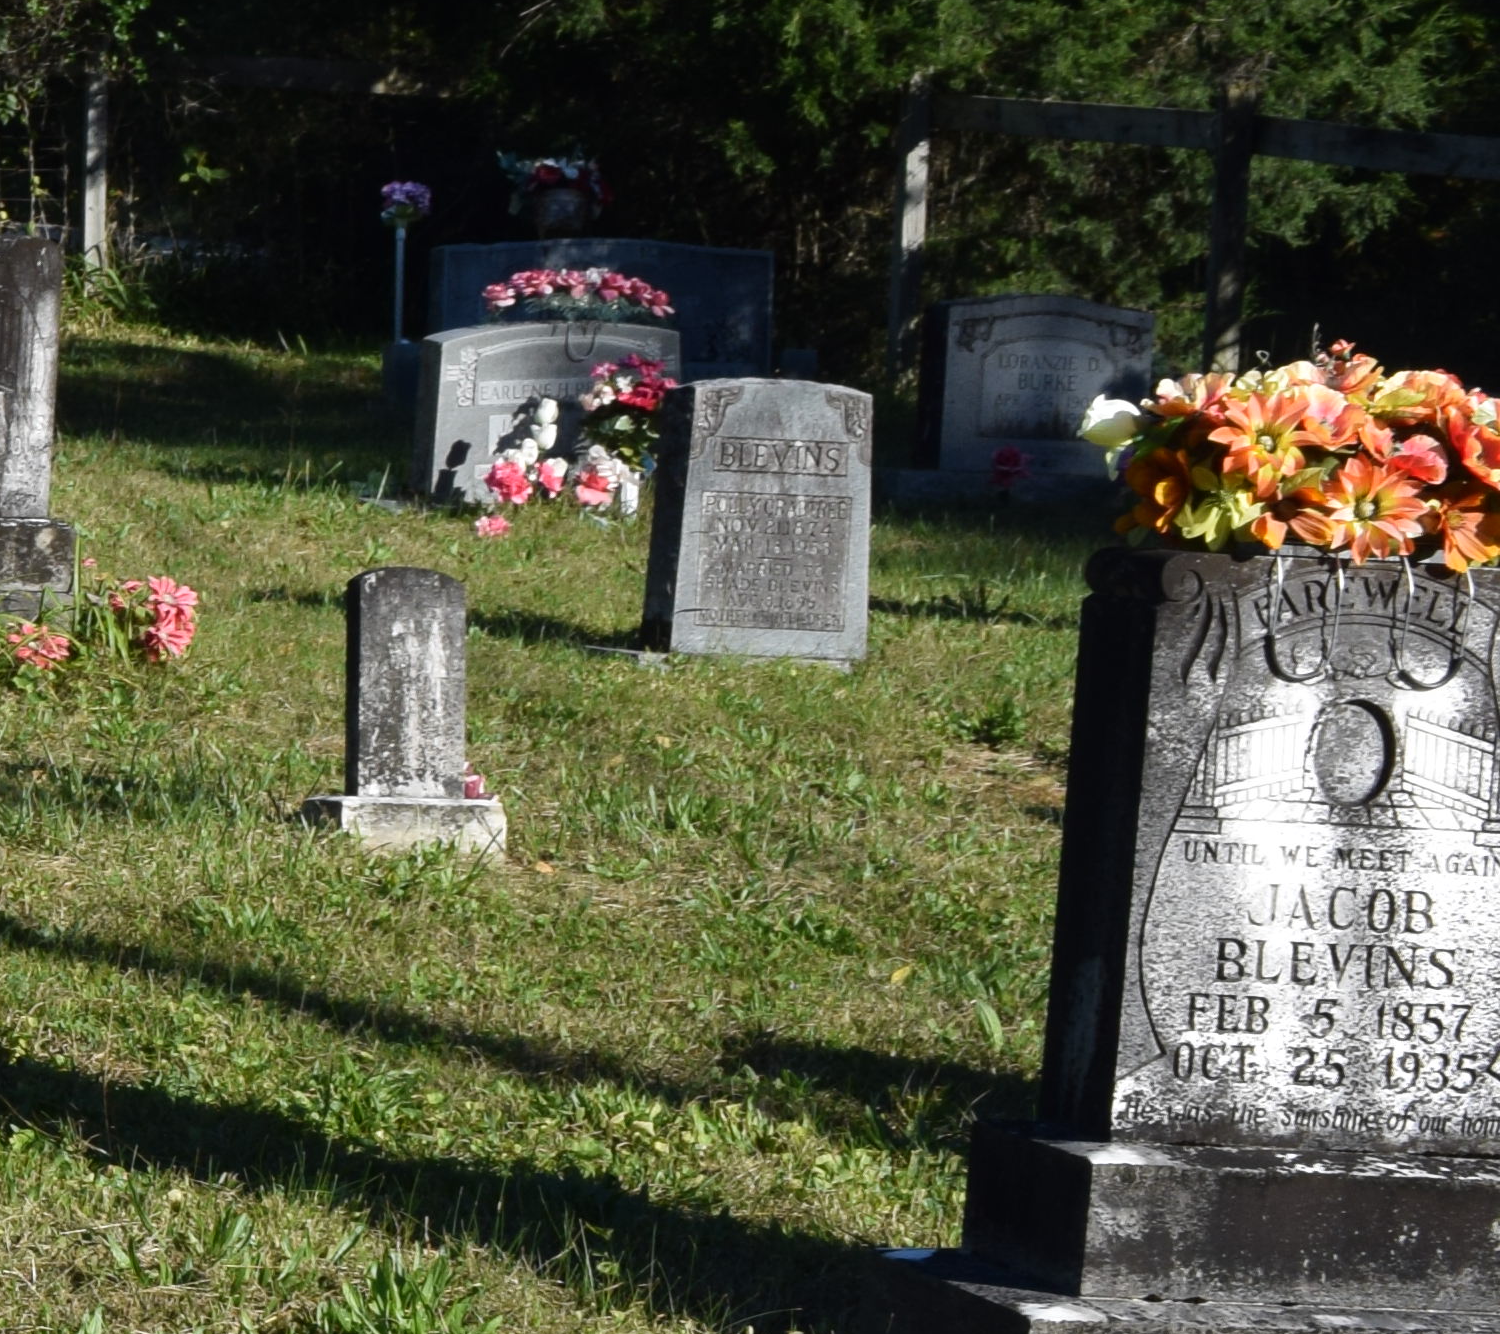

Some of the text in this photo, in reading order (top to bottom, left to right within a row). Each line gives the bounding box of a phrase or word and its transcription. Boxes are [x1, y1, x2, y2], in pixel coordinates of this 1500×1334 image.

[480, 382, 552, 401] EARLENE
[1018, 373, 1077, 392] BURKE
[719, 442, 842, 473] BLEVINS
[703, 496, 760, 515] POLLY
[767, 579, 839, 593] BLEVINS
[1183, 841, 1265, 867] UNTIL
[1280, 845, 1320, 868] WE
[1336, 848, 1412, 874] MEET
[1247, 883, 1436, 935] JACOB
[1213, 937, 1457, 992] BLEVINS
[1182, 992, 1474, 1045] FEB 5 1857
[1172, 1041, 1479, 1096] OCT 25 1935
[1460, 1115, 1500, 1138] hom
